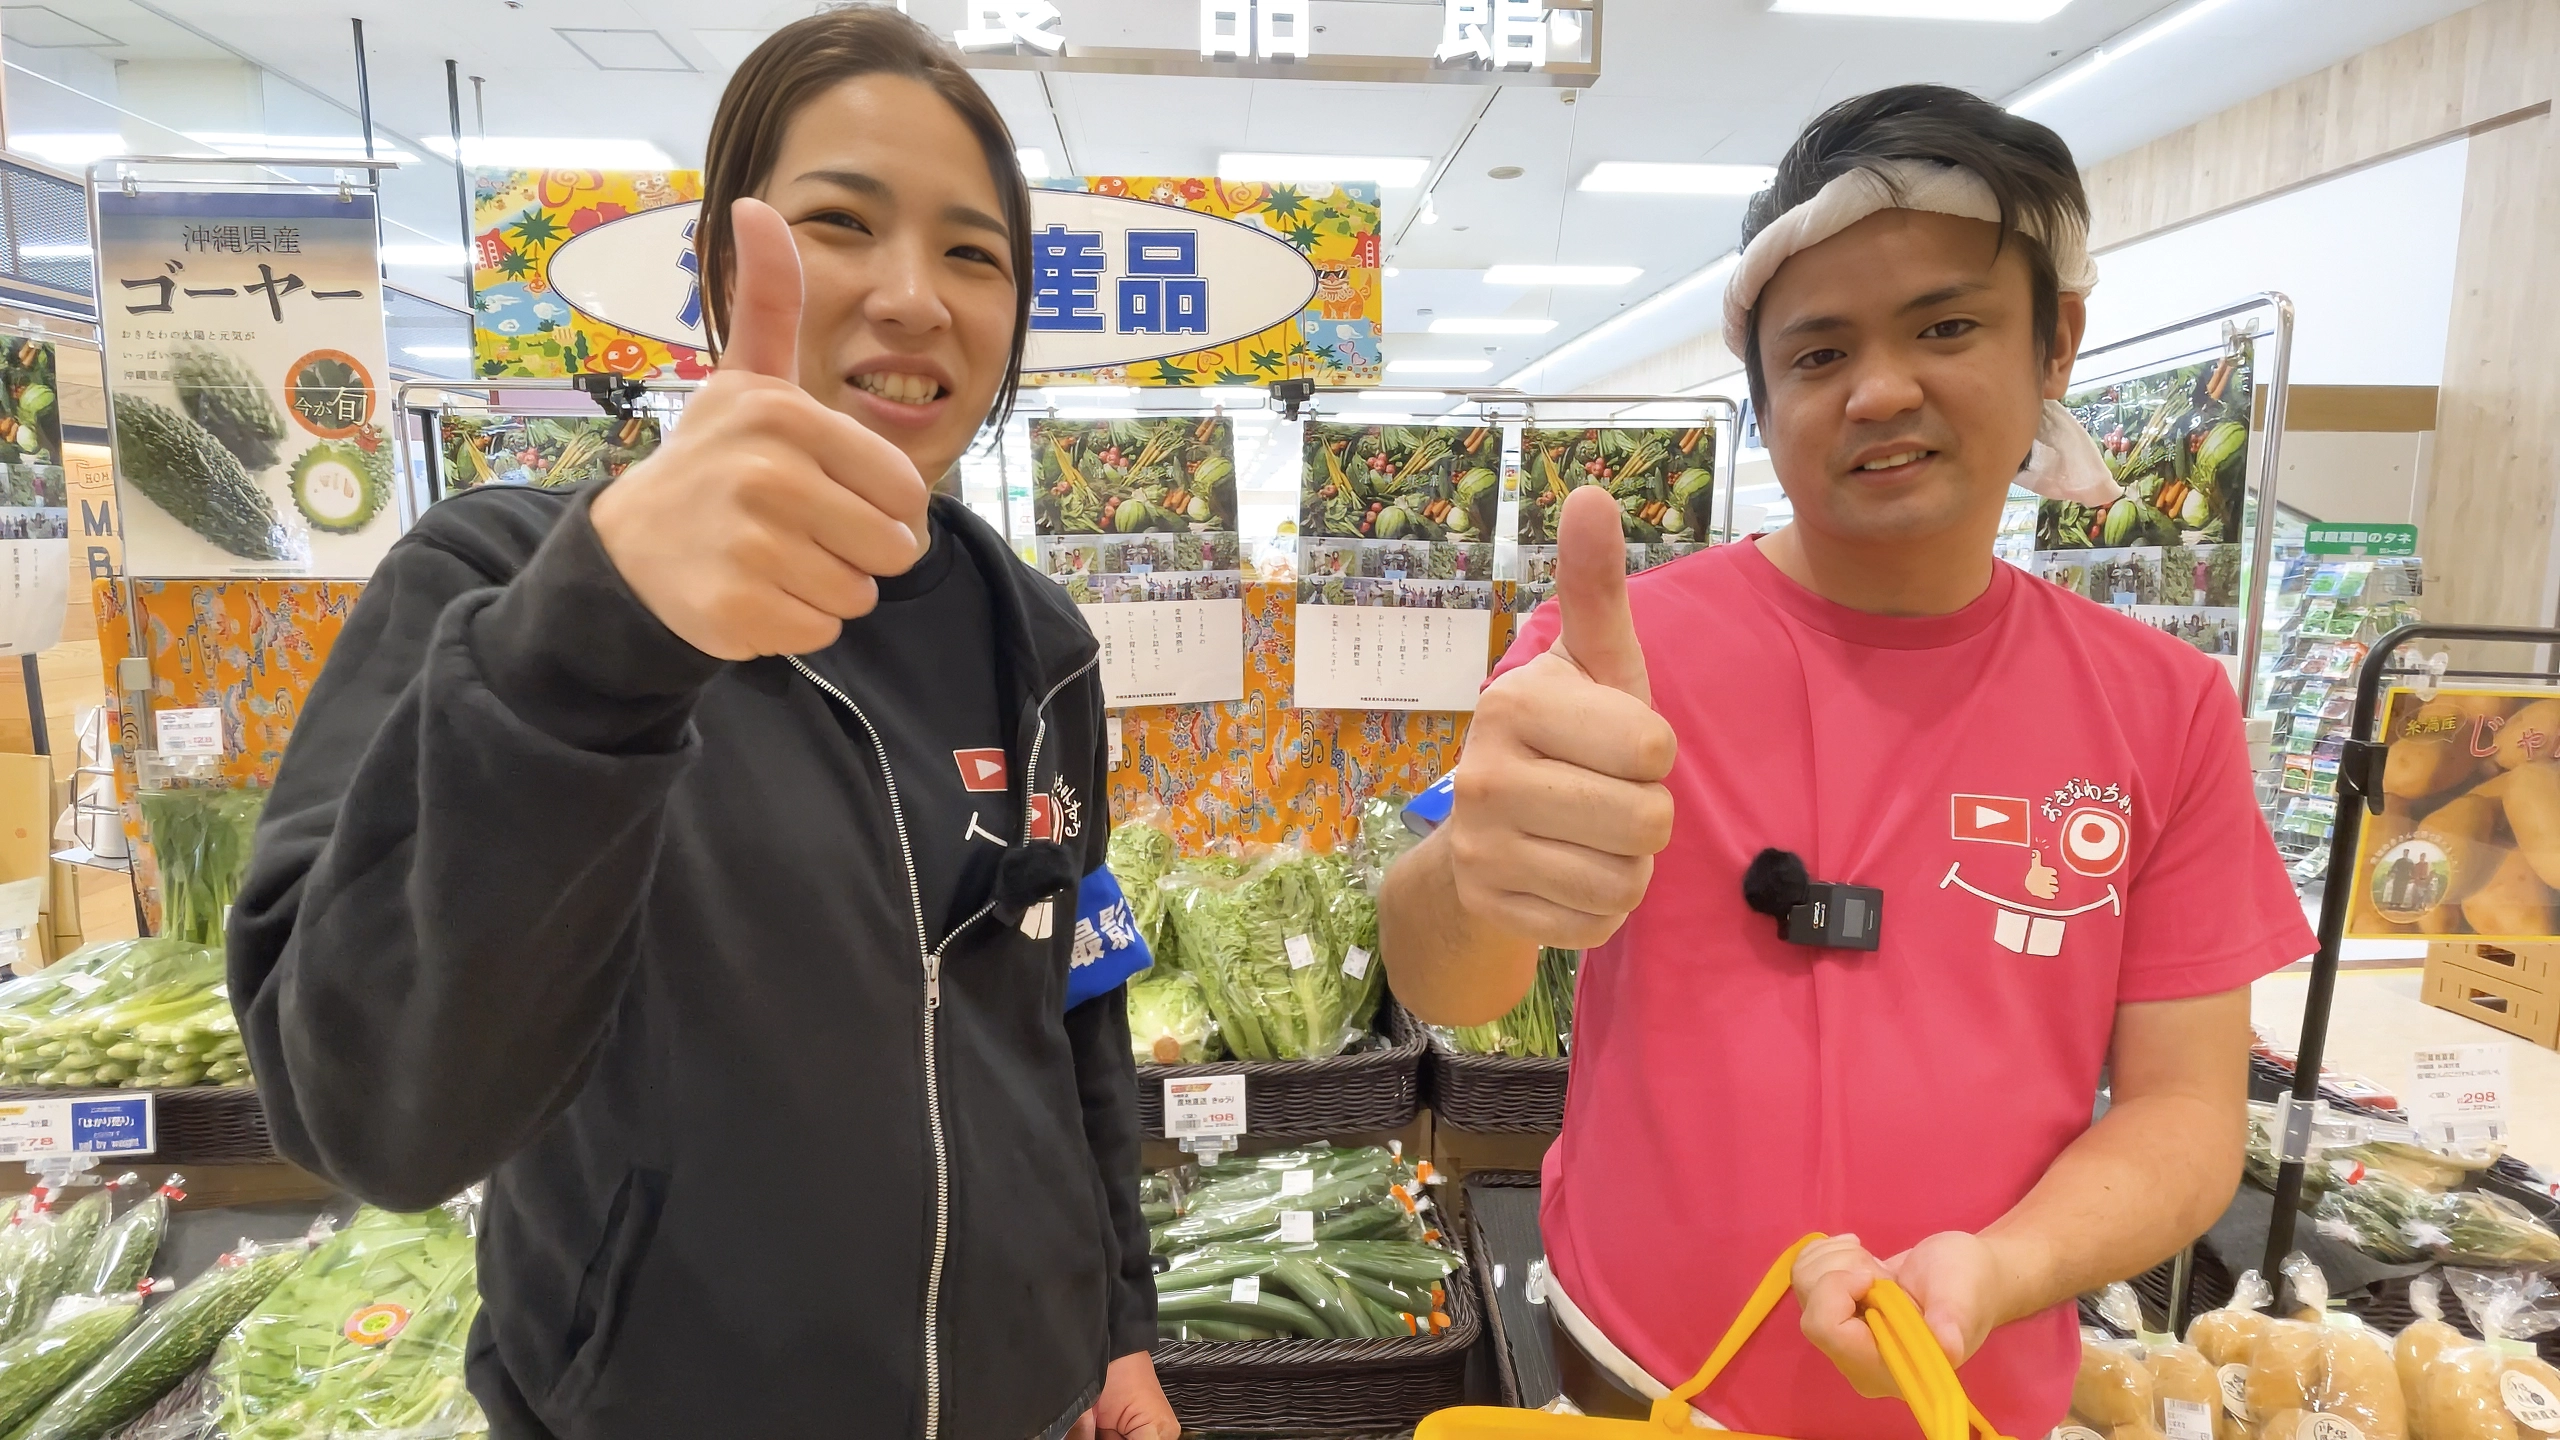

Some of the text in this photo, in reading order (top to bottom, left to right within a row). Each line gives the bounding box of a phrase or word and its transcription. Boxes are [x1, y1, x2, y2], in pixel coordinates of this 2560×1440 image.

[183, 225, 302, 254] 沖縄県産
[121, 259, 365, 322] ゴーヤー
[294, 386, 368, 426] 今が旬
[85, 472, 110, 484] HOM
[2405, 715, 2457, 736] 糸満産
[1069, 898, 1135, 972] 撮影
[2463, 1091, 2496, 1104] 298
[1209, 1113, 1234, 1122] 198
[27, 1136, 54, 1147] 78
